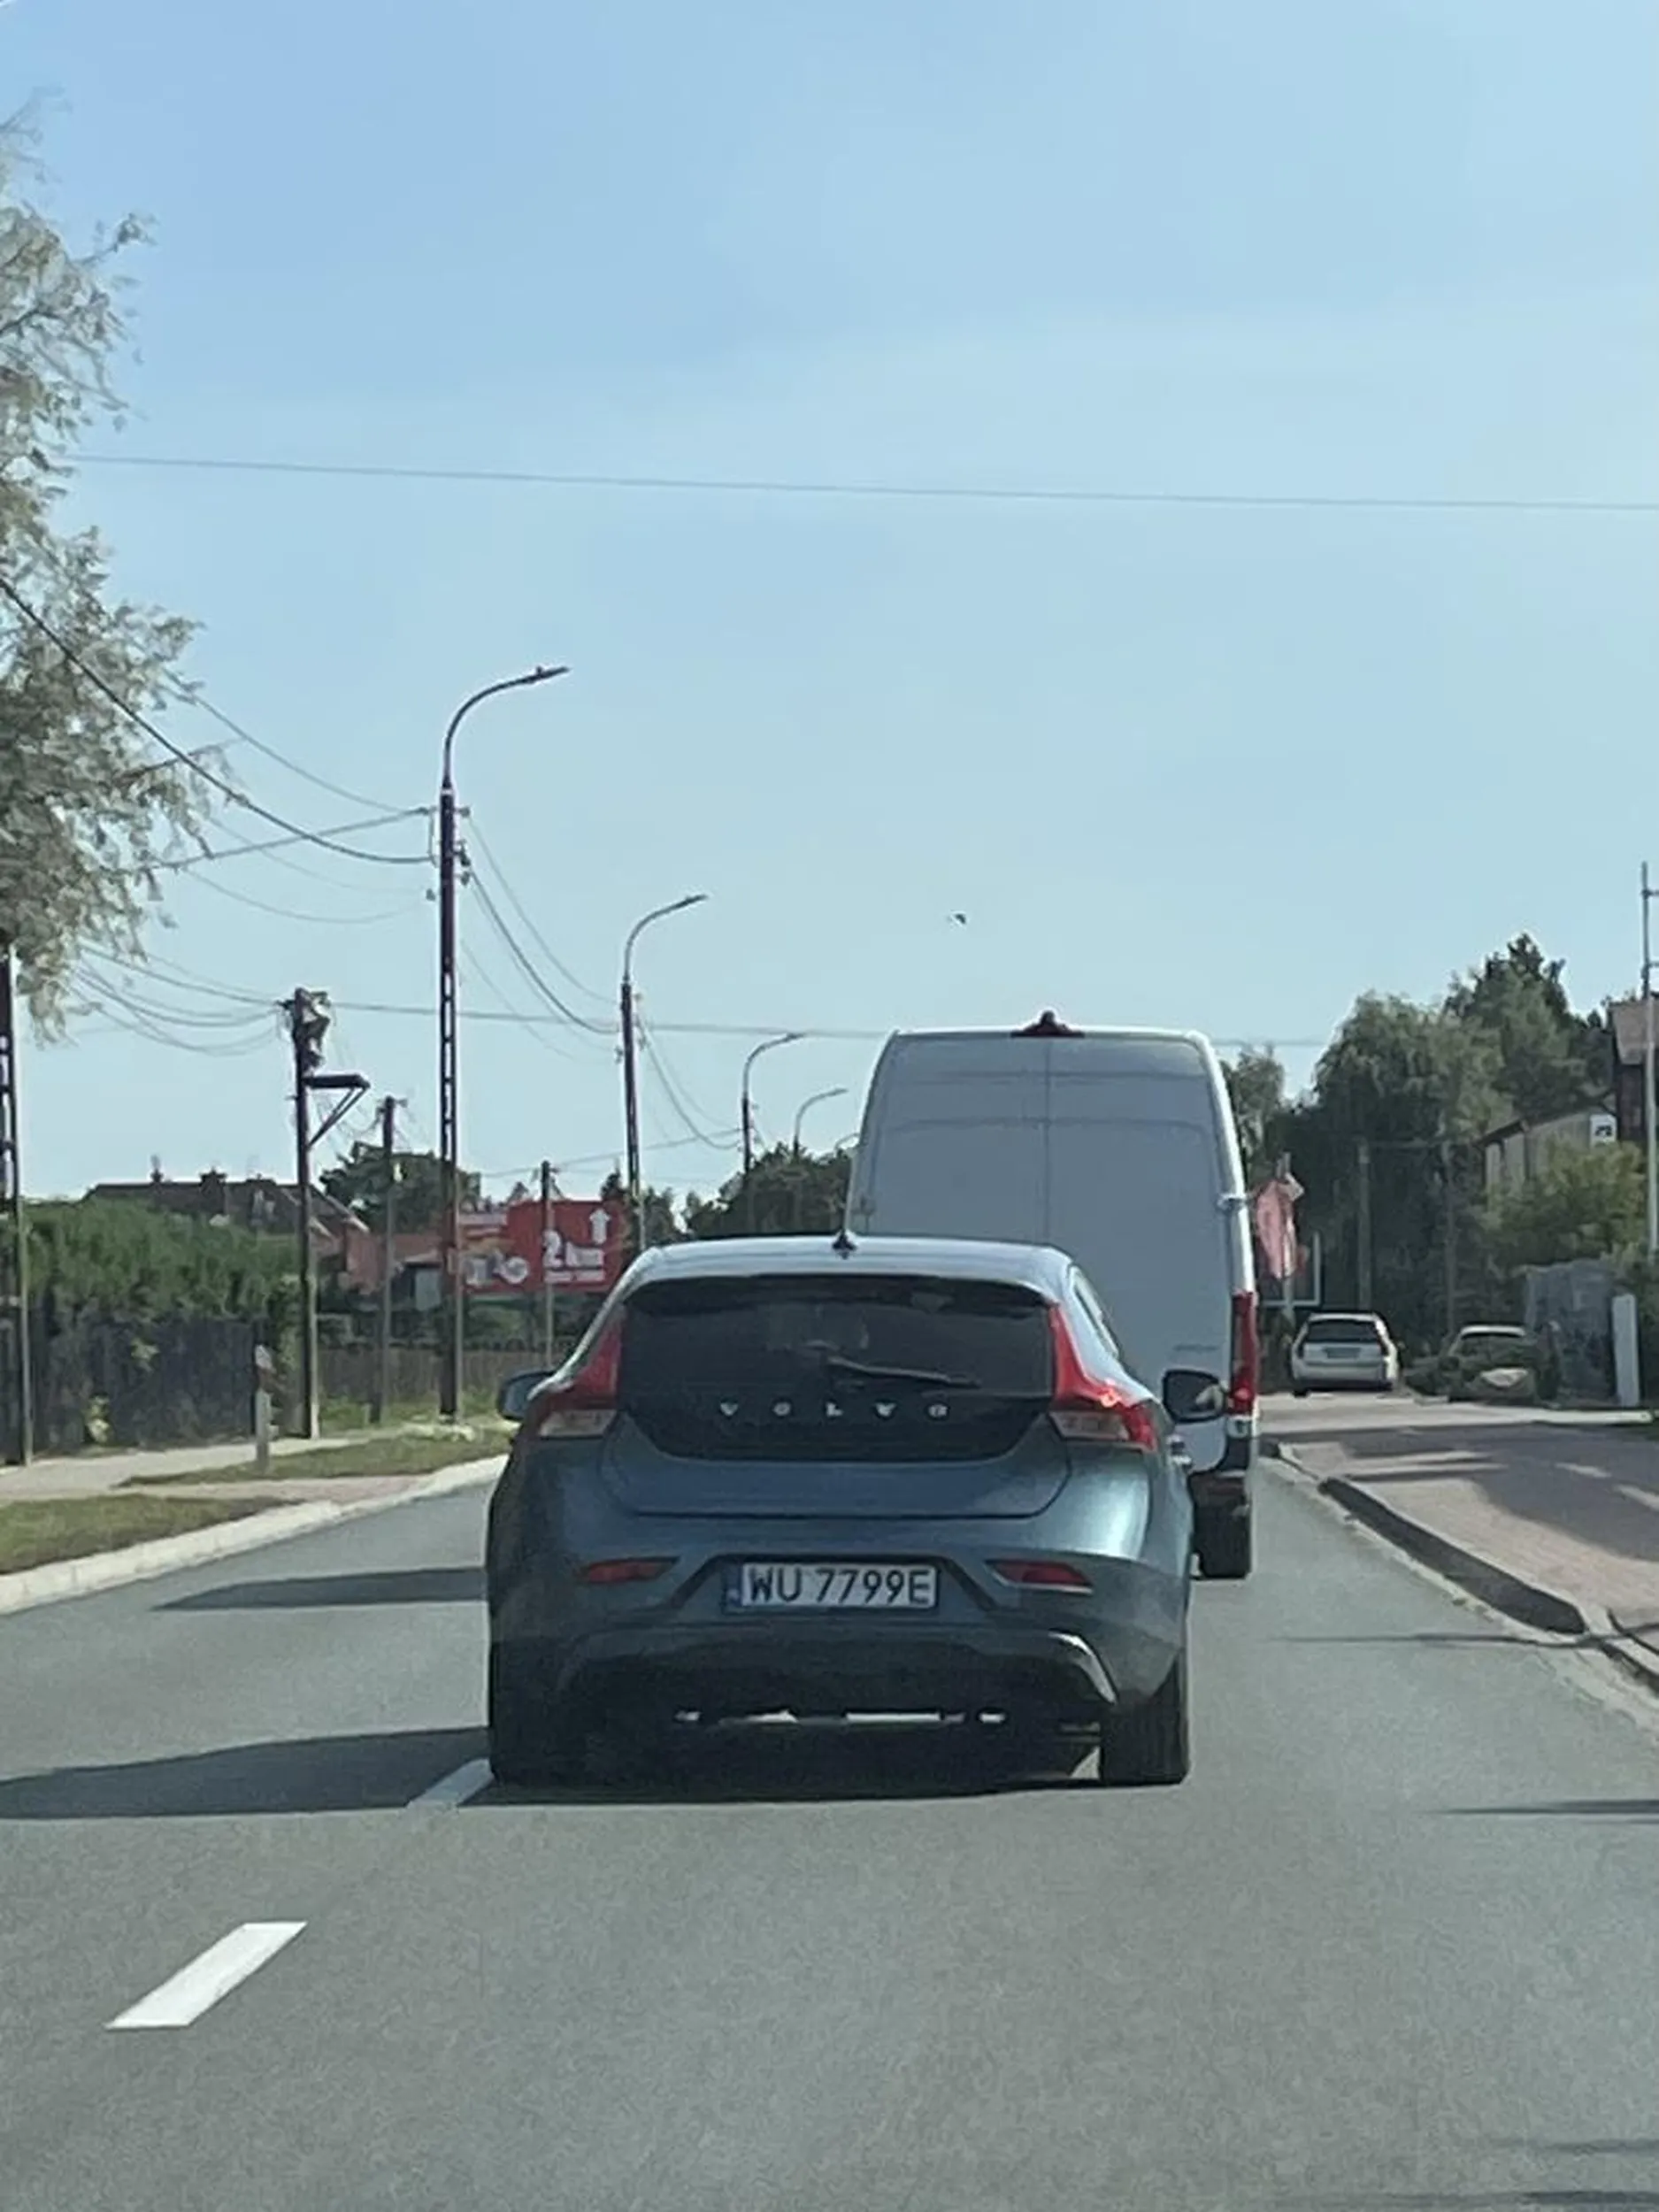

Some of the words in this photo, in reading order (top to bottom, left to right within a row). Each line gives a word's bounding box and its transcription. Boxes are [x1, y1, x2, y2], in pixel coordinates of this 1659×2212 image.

[719, 1402, 949, 1417] VOLVO
[748, 1567, 802, 1602] WU
[814, 1568, 930, 1605] 7799E
